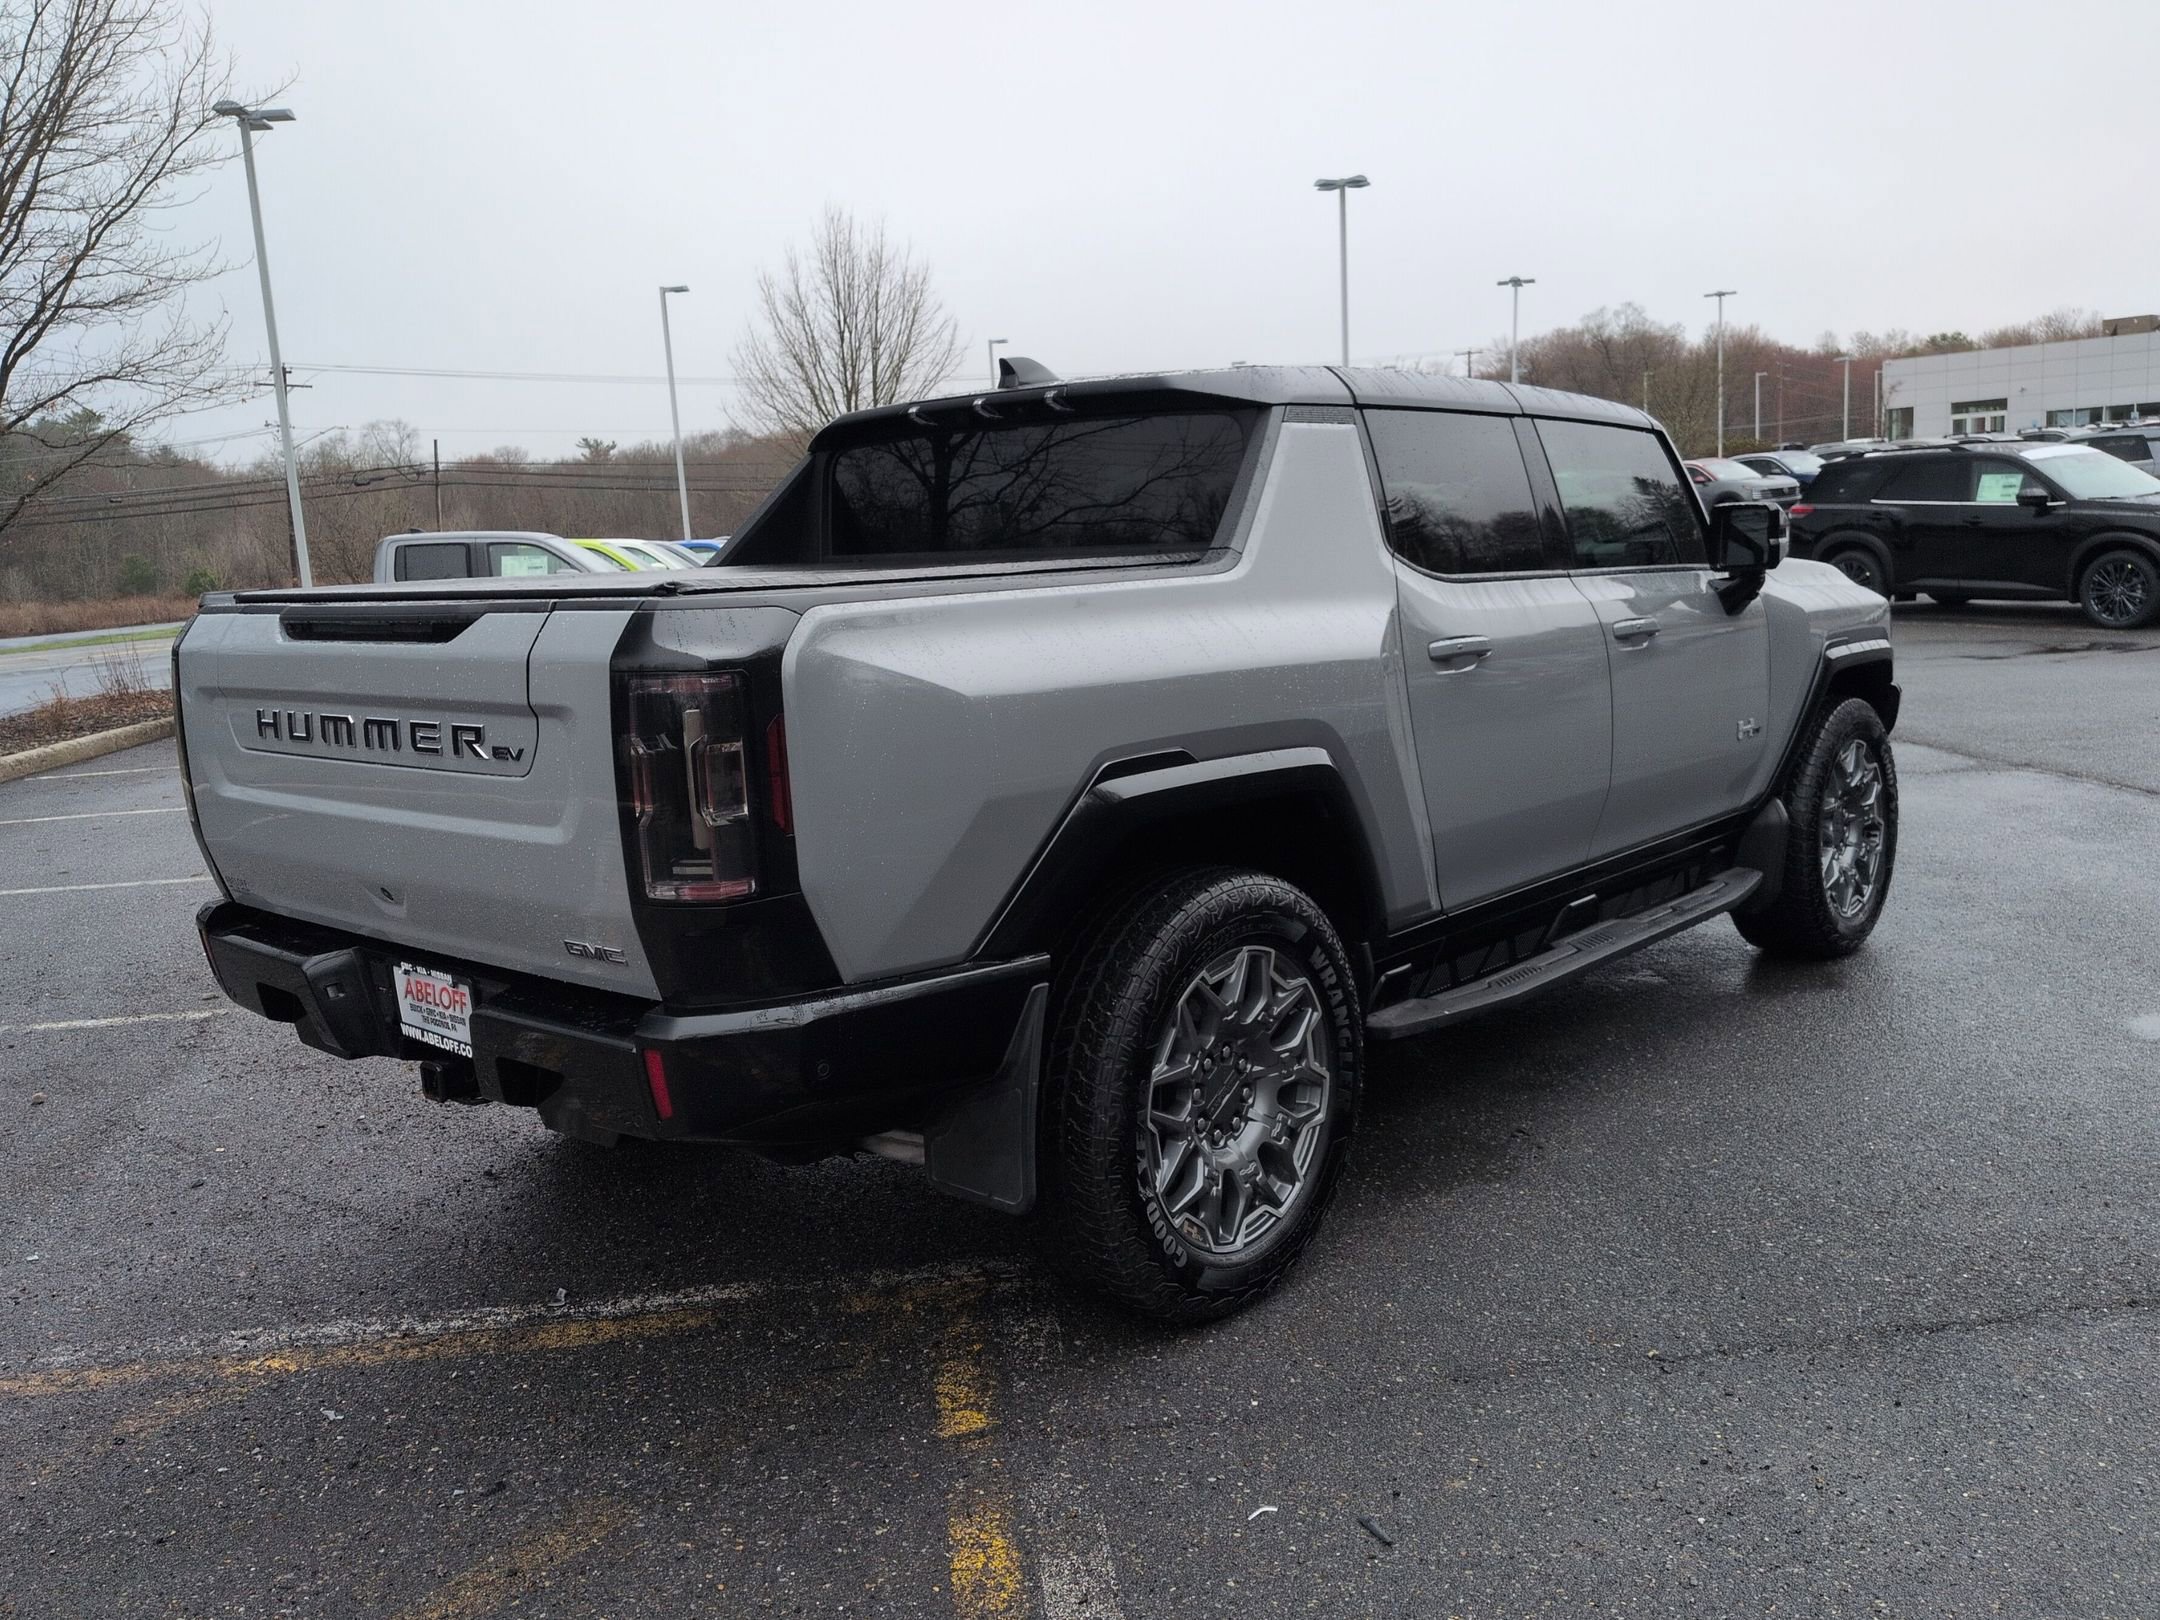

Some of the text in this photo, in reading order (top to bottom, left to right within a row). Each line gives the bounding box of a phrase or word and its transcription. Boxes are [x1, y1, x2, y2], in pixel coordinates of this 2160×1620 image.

[256, 708, 524, 761] HUMMER EV
[564, 939, 628, 966] GMC
[404, 977, 467, 1014] ABELOFF
